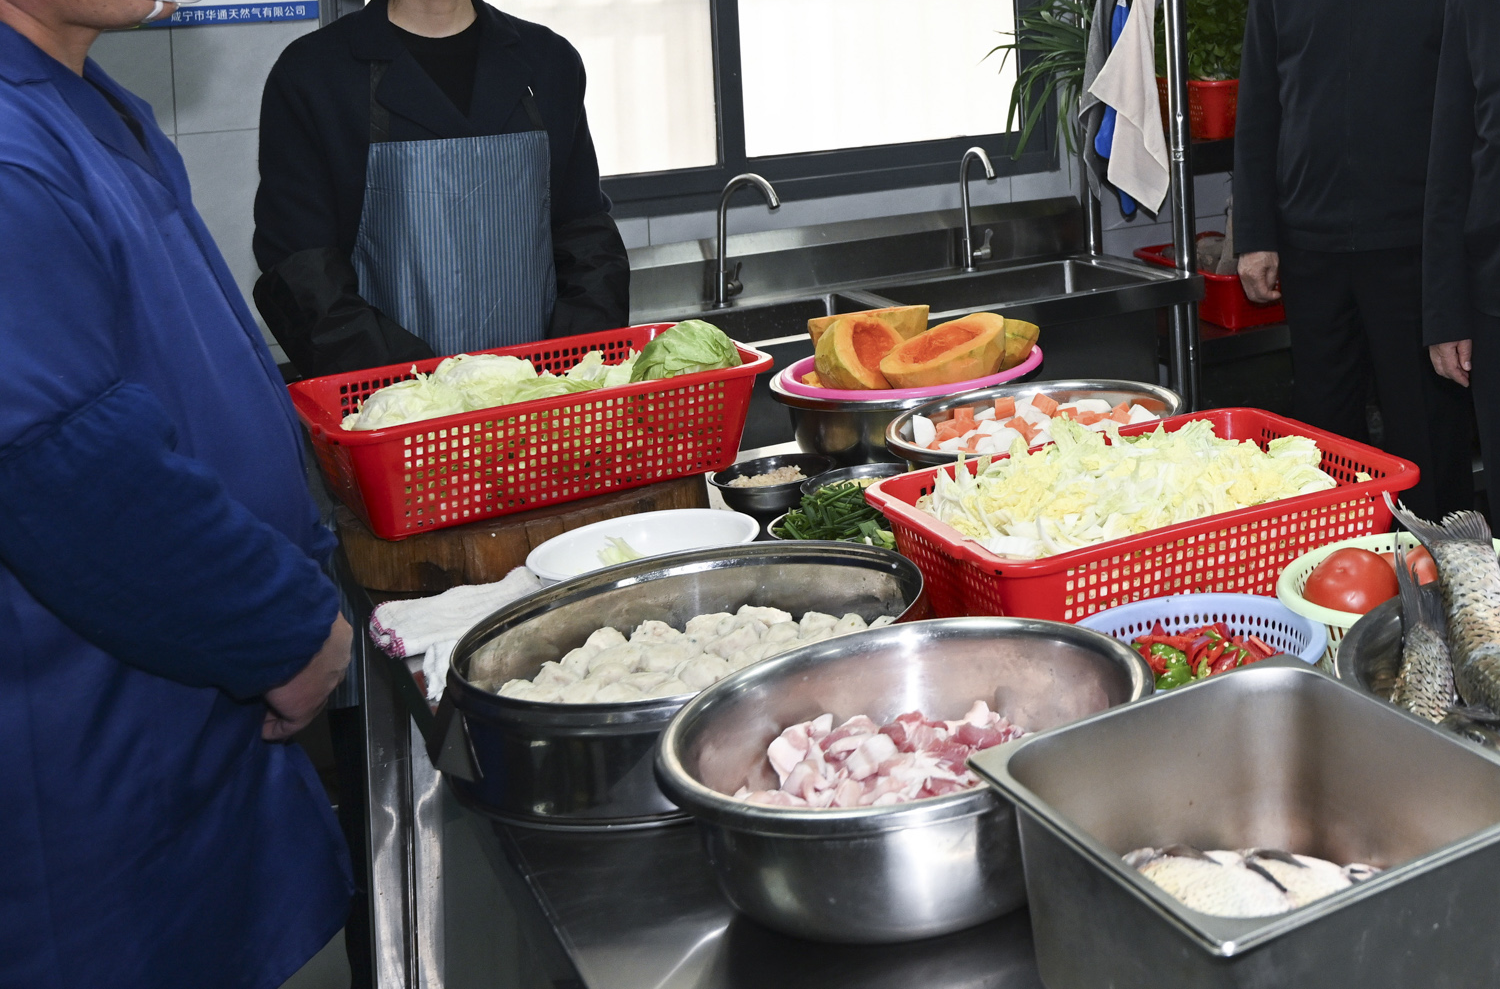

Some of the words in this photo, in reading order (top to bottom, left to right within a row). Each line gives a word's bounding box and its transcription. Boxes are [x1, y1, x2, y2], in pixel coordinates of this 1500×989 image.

[170, 5, 306, 22] 咸宁市华通天然气有限公司
